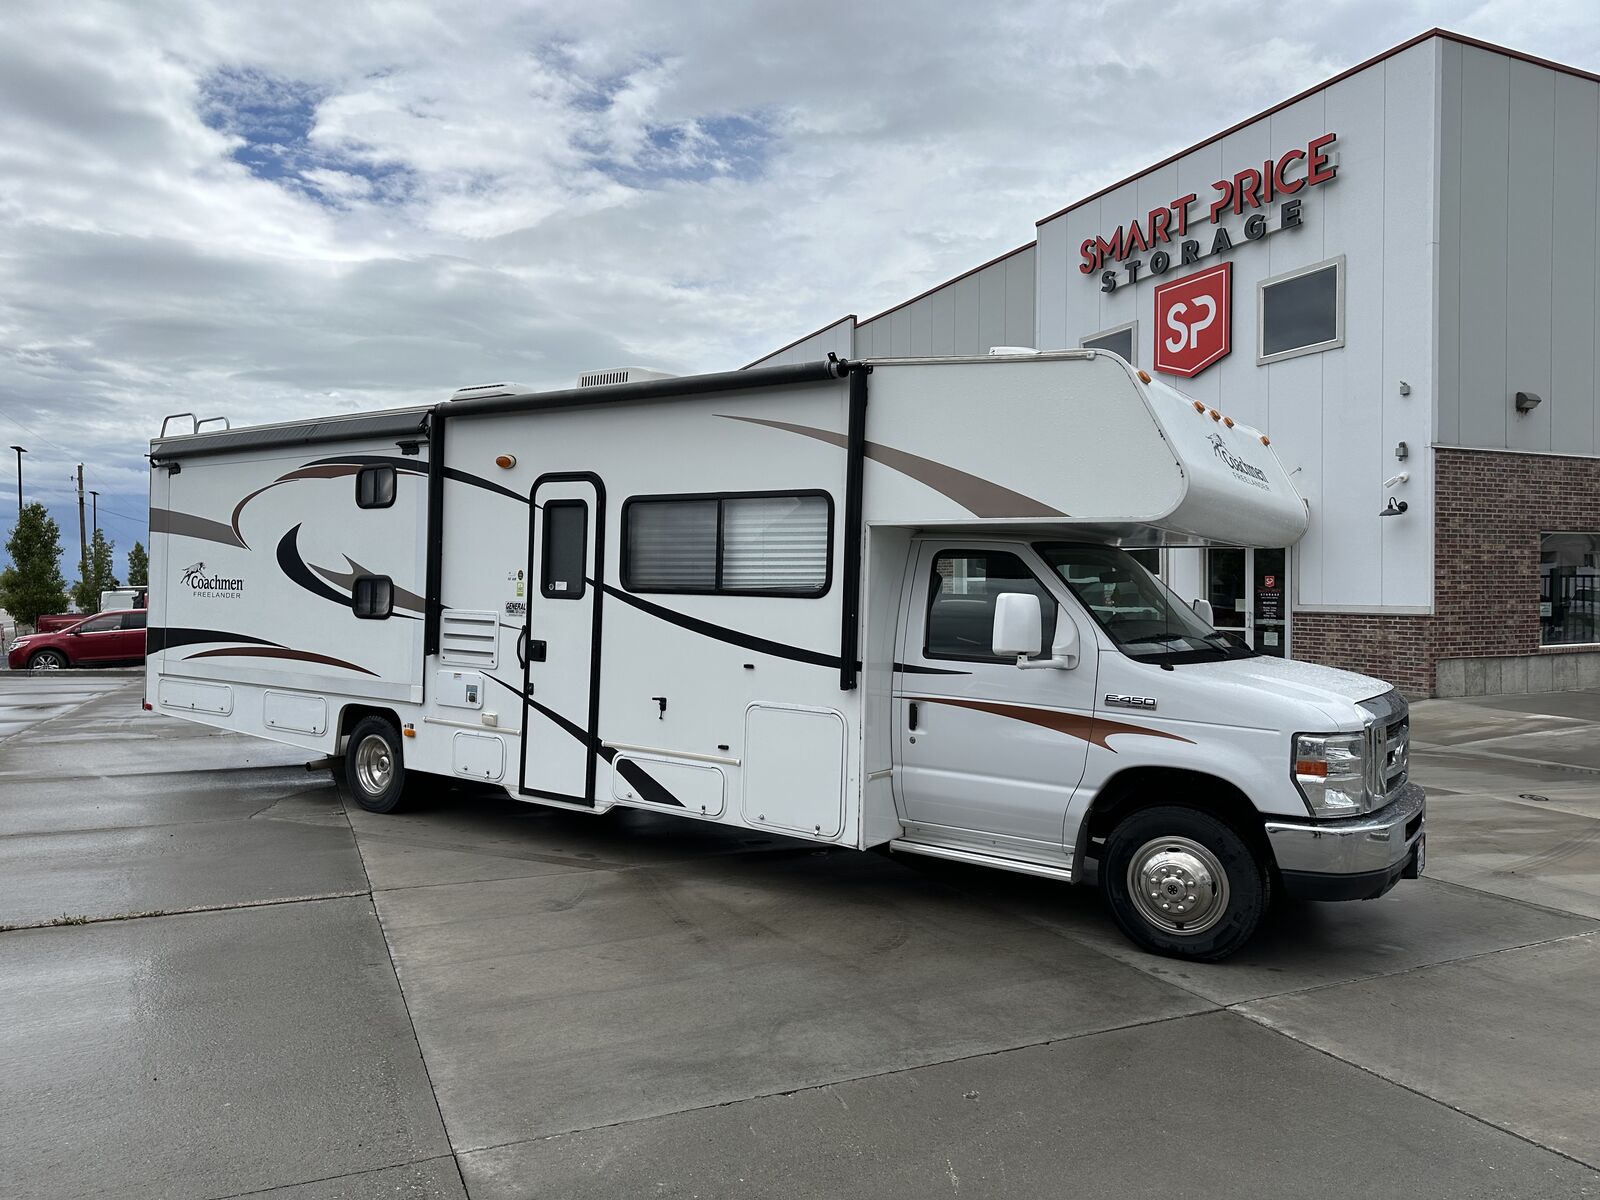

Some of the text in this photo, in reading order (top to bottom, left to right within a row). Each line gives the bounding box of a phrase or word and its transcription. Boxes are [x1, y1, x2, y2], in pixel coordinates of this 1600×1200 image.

[1079, 132, 1337, 274] SMART PRICE
[1100, 199, 1302, 293] STORAGE
[1165, 294, 1217, 353] SP
[191, 574, 244, 591] Coachmen
[193, 591, 241, 599] FREELANDER
[505, 602, 526, 610] GENERAL
